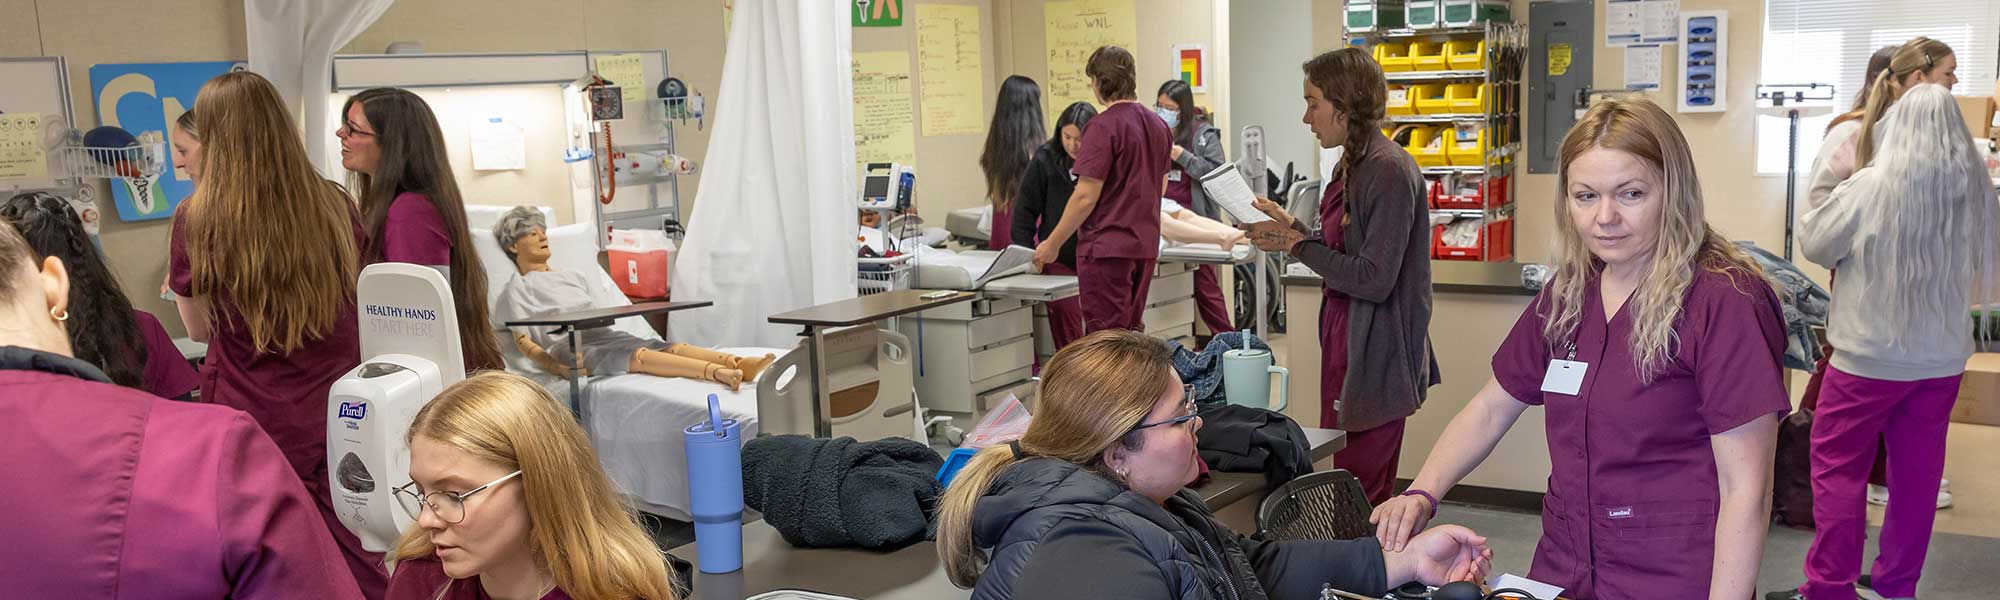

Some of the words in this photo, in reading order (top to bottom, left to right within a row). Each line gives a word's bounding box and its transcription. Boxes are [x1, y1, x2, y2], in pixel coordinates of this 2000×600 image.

[1084, 16, 1112, 28] WNL
[366, 304, 402, 318] HEALTHY
[405, 308, 436, 321] HANDS
[370, 319, 401, 336] START
[406, 321, 433, 337] HERE
